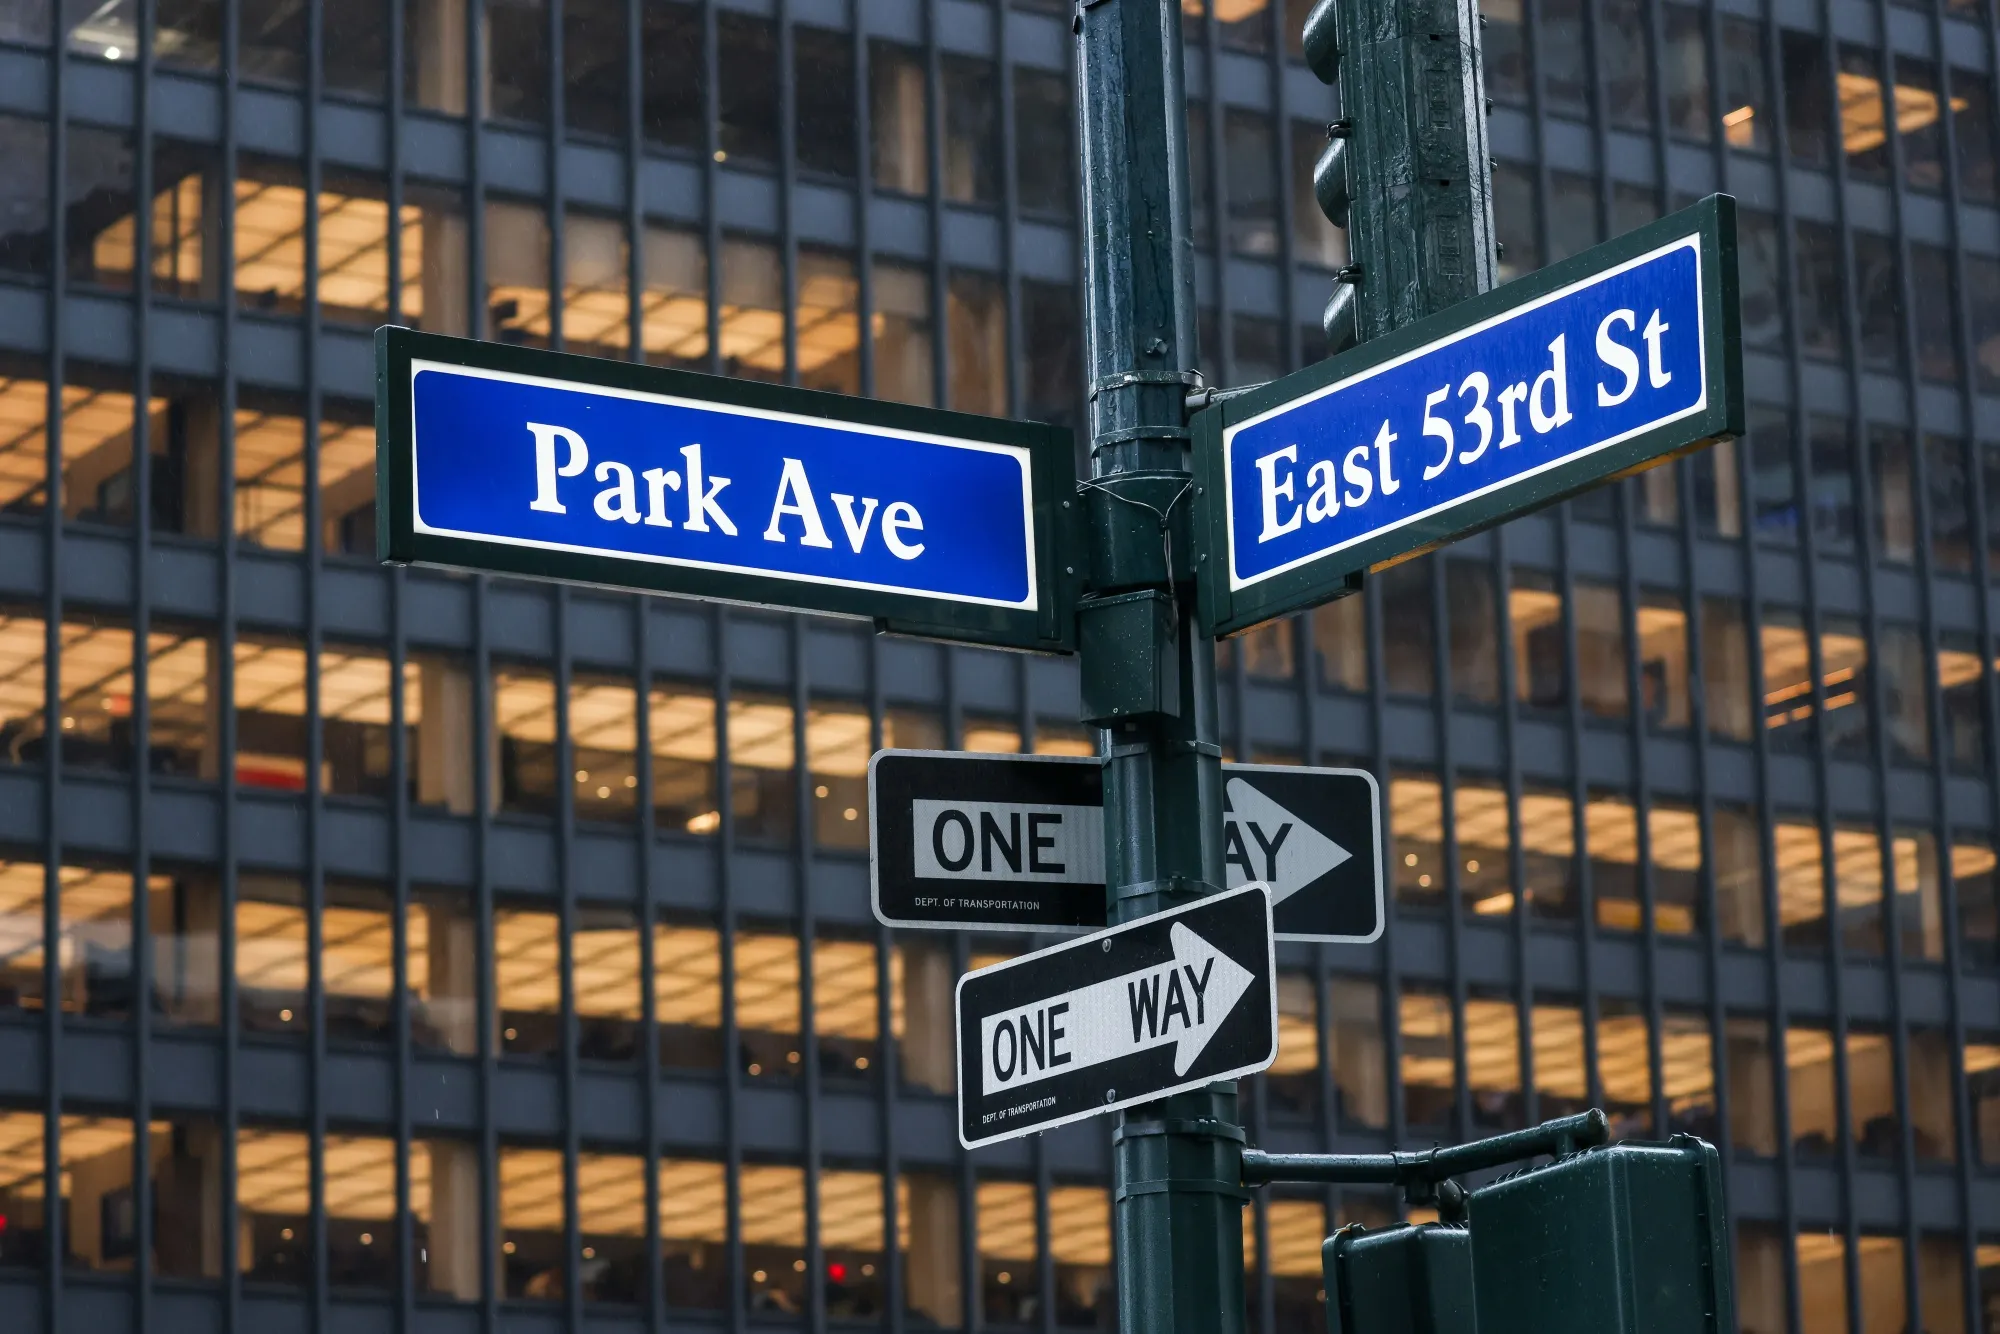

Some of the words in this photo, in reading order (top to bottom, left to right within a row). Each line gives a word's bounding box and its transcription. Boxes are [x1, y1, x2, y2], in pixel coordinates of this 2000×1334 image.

[1254, 418, 1401, 545] East
[1421, 332, 1573, 482] 53rd
[1595, 307, 1673, 407] St
[526, 421, 738, 536] Park
[763, 457, 926, 561] Ave
[932, 809, 1066, 874] ONE
[1224, 820, 1294, 882] AY
[914, 897, 941, 908] DEPT.
[943, 898, 956, 908] OF
[958, 898, 1040, 911] TRANSPORTATION
[992, 1001, 1072, 1083] ONE
[1127, 956, 1216, 1044] WAY
[982, 1111, 998, 1125] DEPT.
[998, 1109, 1007, 1120] OF
[1007, 1095, 1057, 1117] TRANSPORTATION
